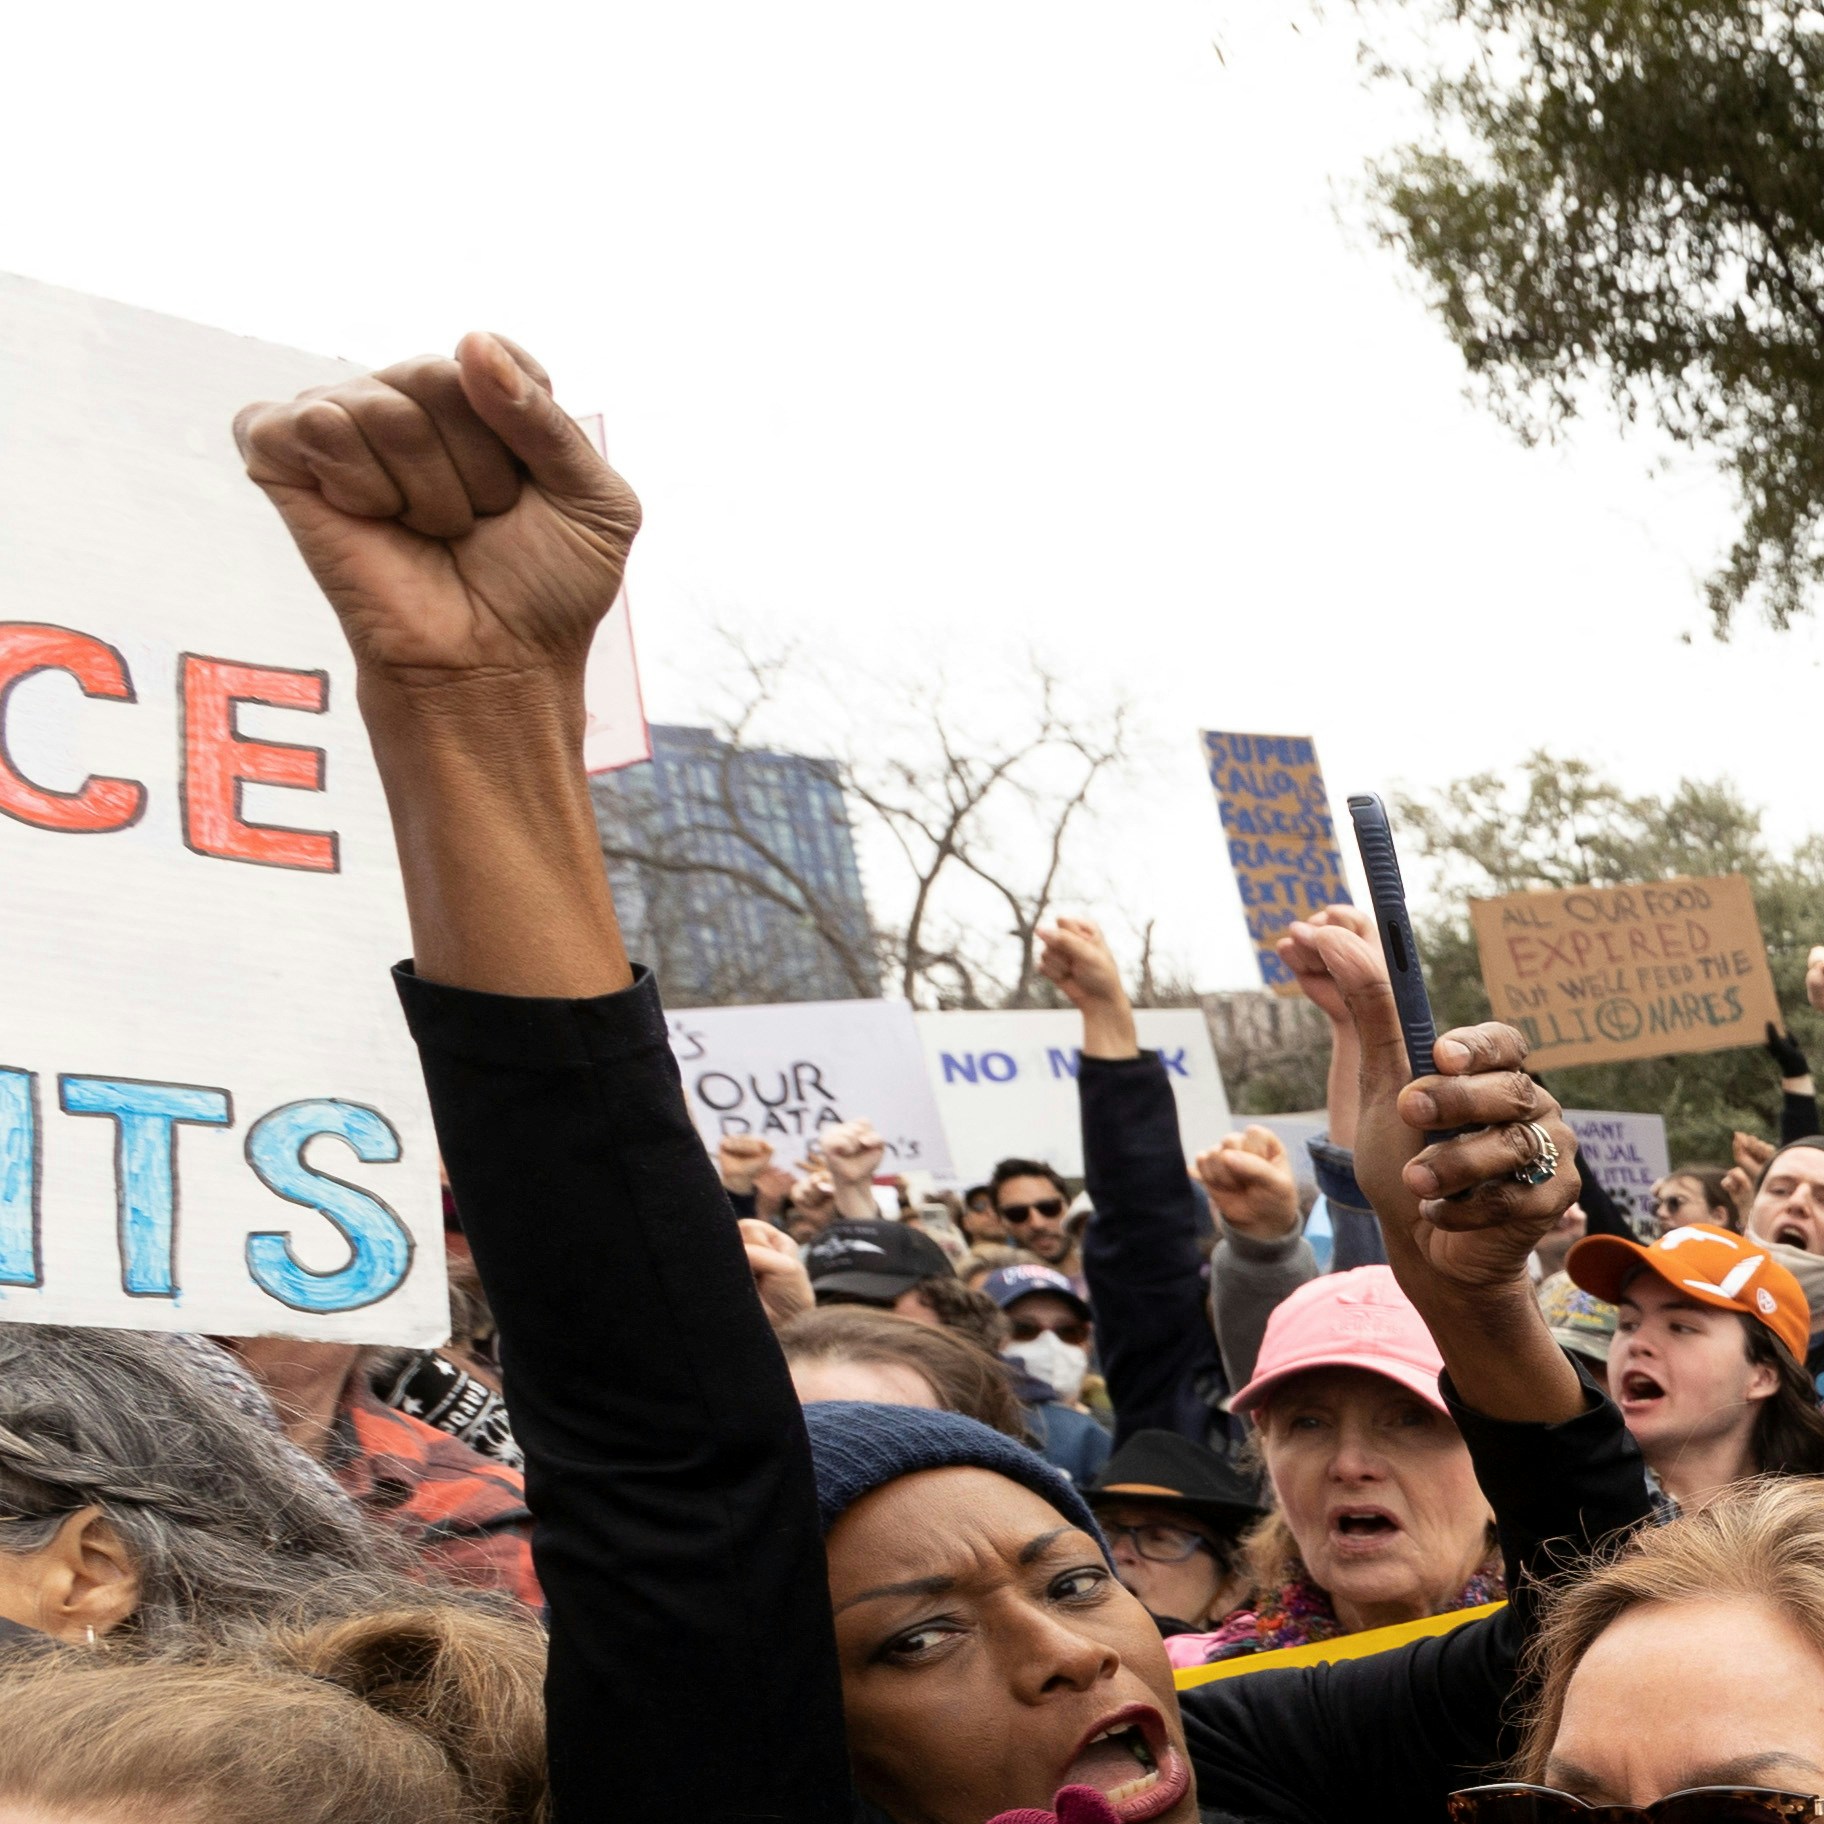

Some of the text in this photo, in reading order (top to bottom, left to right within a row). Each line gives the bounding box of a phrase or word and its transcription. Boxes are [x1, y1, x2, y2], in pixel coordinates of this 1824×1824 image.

[1563, 890, 1641, 924] OUR
[1643, 886, 1712, 917] FOOD
[1505, 919, 1711, 979] EXPIRED
[1697, 949, 1753, 980] THE
[696, 1062, 836, 1111] OUR
[940, 1051, 1018, 1084] NO
